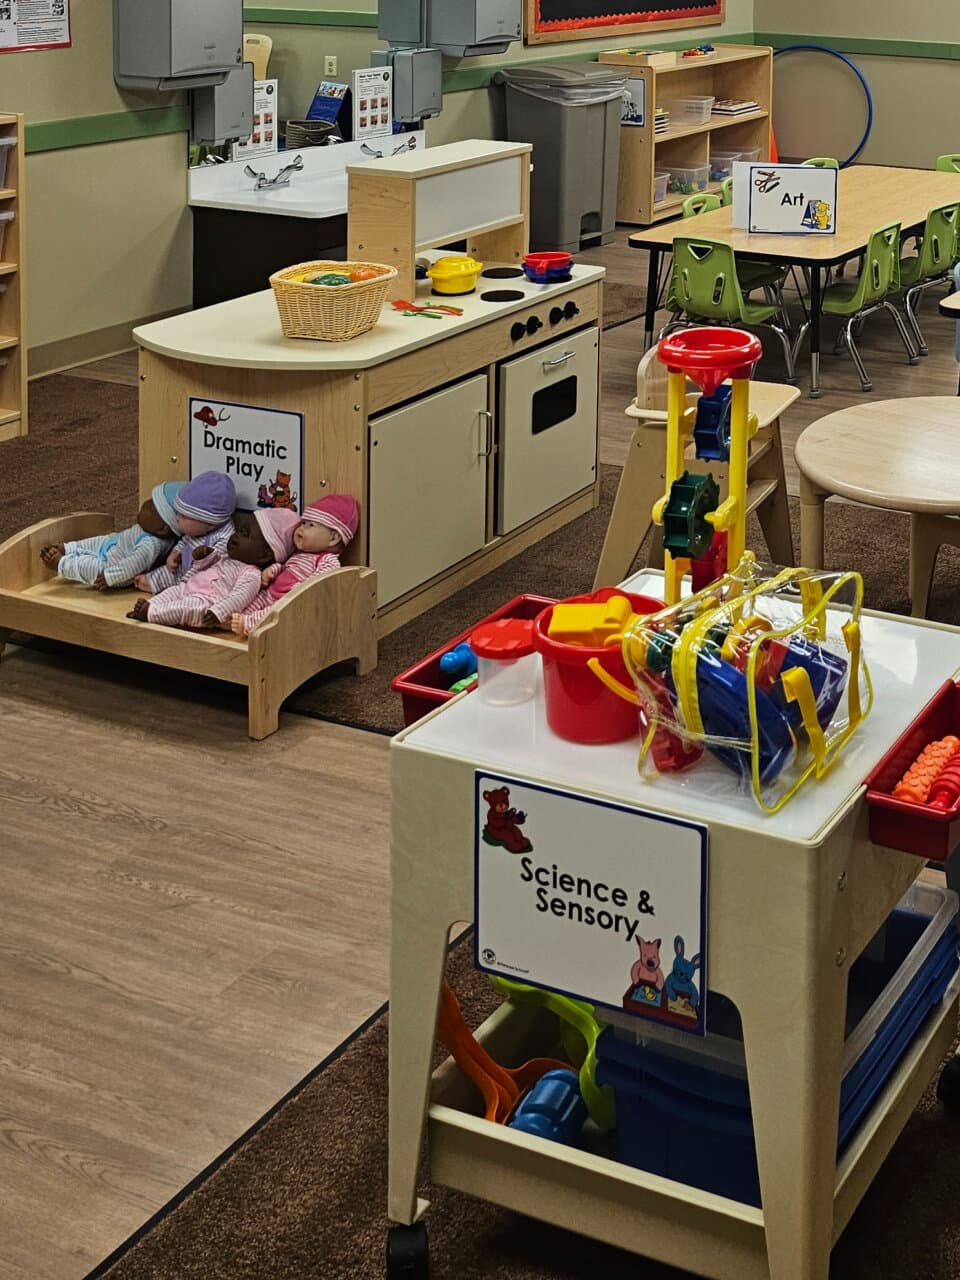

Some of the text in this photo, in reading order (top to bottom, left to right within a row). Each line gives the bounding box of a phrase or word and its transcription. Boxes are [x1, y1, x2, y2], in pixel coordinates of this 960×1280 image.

[780, 192, 805, 206] Art
[204, 430, 287, 460] Dramatic
[226, 455, 264, 482] Play
[520, 857, 655, 916] Science &
[535, 887, 639, 942] Sensory
